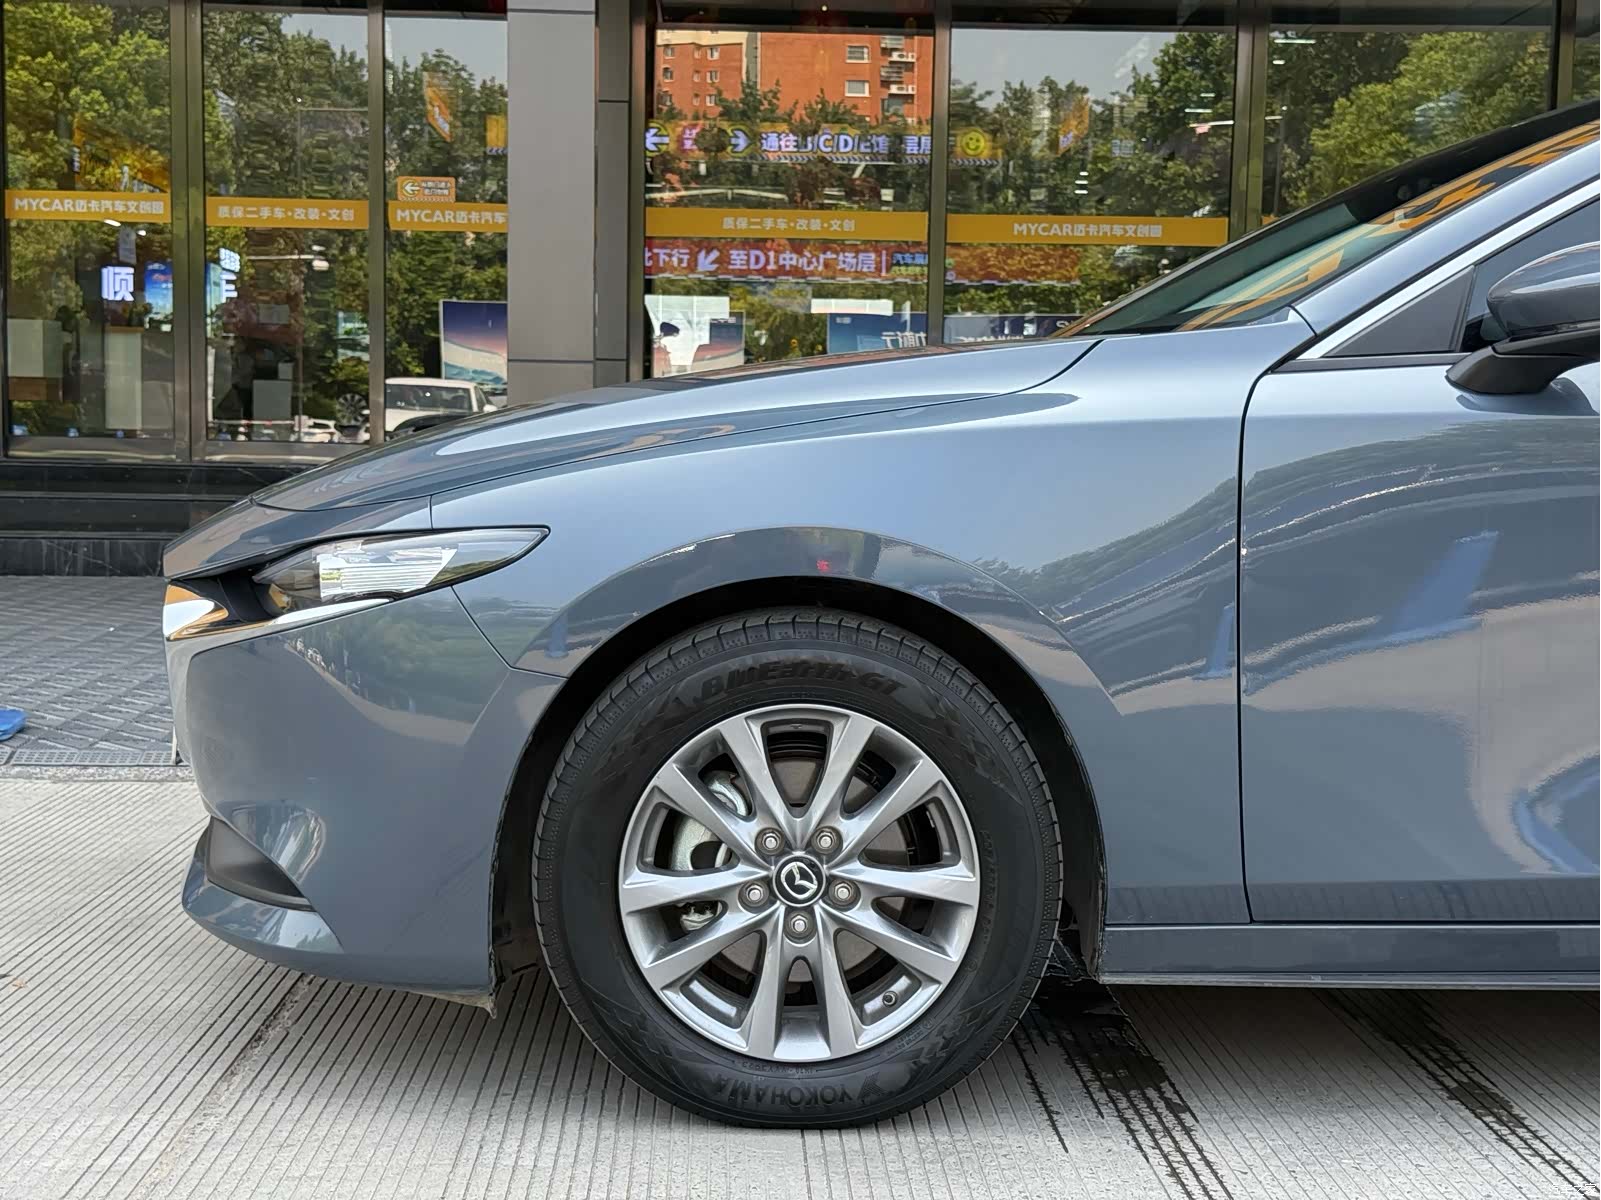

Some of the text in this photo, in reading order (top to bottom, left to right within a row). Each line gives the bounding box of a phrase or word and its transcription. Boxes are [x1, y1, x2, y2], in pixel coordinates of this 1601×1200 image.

[728, 249, 876, 273] 至D1中心广场层
[707, 1072, 853, 1108] YOKOHAMA
